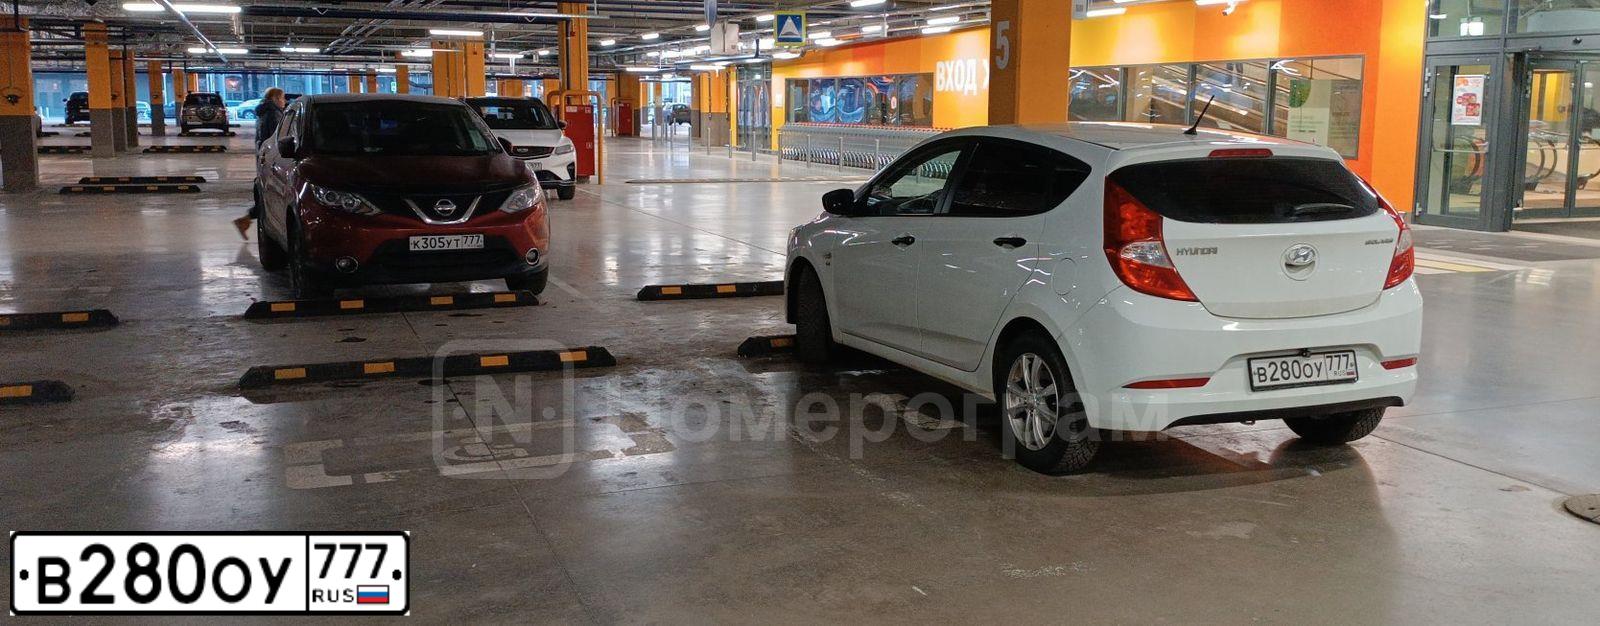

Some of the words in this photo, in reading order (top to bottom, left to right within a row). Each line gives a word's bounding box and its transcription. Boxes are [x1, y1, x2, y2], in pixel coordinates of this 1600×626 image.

[996, 21, 1010, 70] 5
[936, 59, 977, 95] ВХОД
[413, 236, 461, 249] К305УТ
[463, 235, 480, 245] 777
[1176, 247, 1218, 256] HYUNDAI
[1257, 360, 1322, 383] В280ОУ
[1325, 354, 1350, 371] 777
